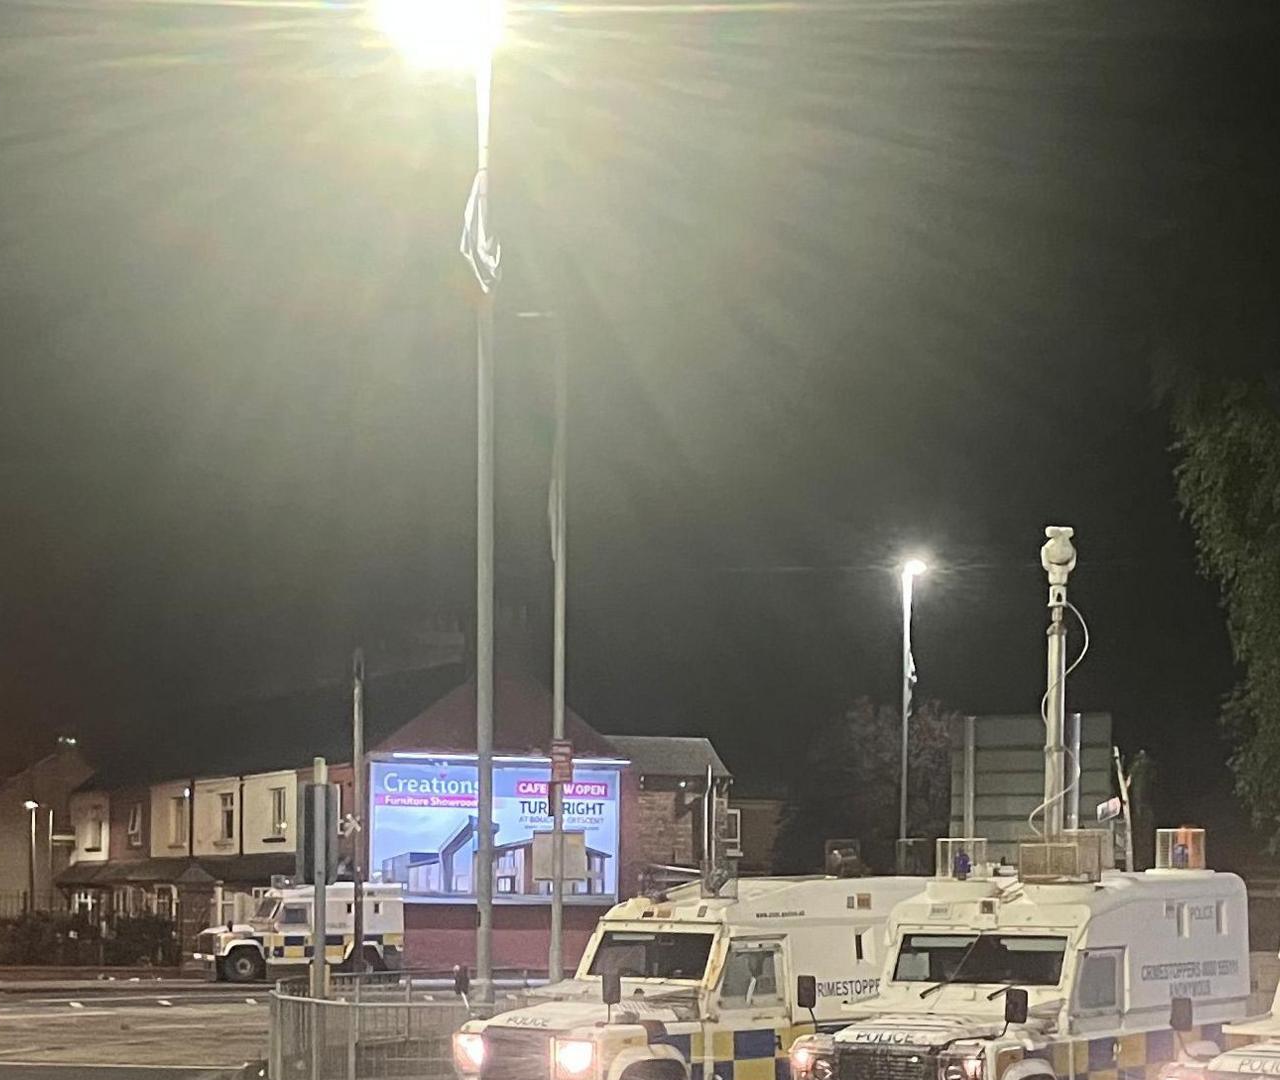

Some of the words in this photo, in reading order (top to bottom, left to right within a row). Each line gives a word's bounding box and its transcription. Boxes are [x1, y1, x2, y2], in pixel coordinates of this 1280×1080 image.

[518, 782, 548, 794] CAFE
[576, 784, 606, 796] OPEN
[384, 795, 429, 806] Furniture
[520, 800, 548, 815] TUR
[562, 801, 605, 816] RIGHT
[856, 1032, 915, 1045] POLICE
